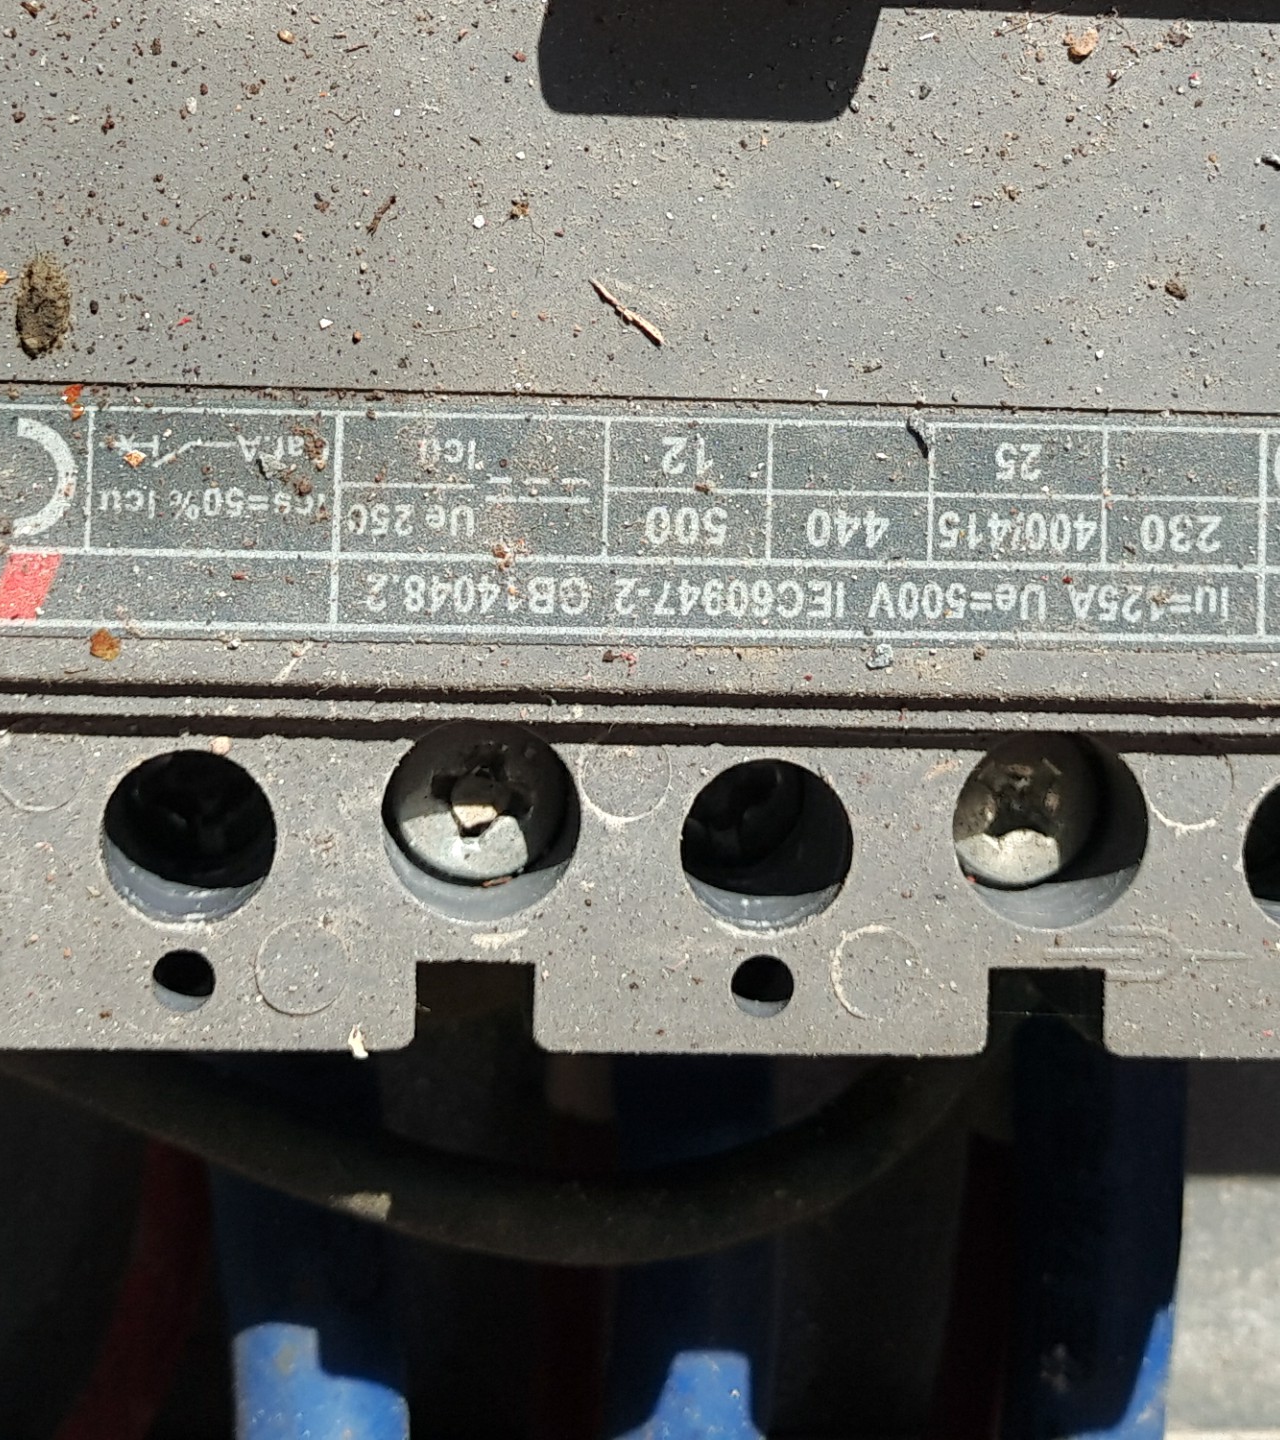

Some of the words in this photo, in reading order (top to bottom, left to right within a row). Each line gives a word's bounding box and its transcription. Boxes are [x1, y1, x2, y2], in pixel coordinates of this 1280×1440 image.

[661, 435, 713, 477] 12
[994, 441, 1044, 481] 25
[98, 487, 157, 520] Icu
[346, 502, 415, 538] 250
[425, 503, 475, 538] Ue
[644, 506, 728, 548] 500
[806, 508, 890, 549] 440
[938, 510, 1098, 553] 400/415
[1140, 513, 1222, 554] 230
[365, 572, 592, 616] GB14048.2
[614, 577, 846, 621] IEC60947-2
[867, 581, 1047, 623] Ue=500V
